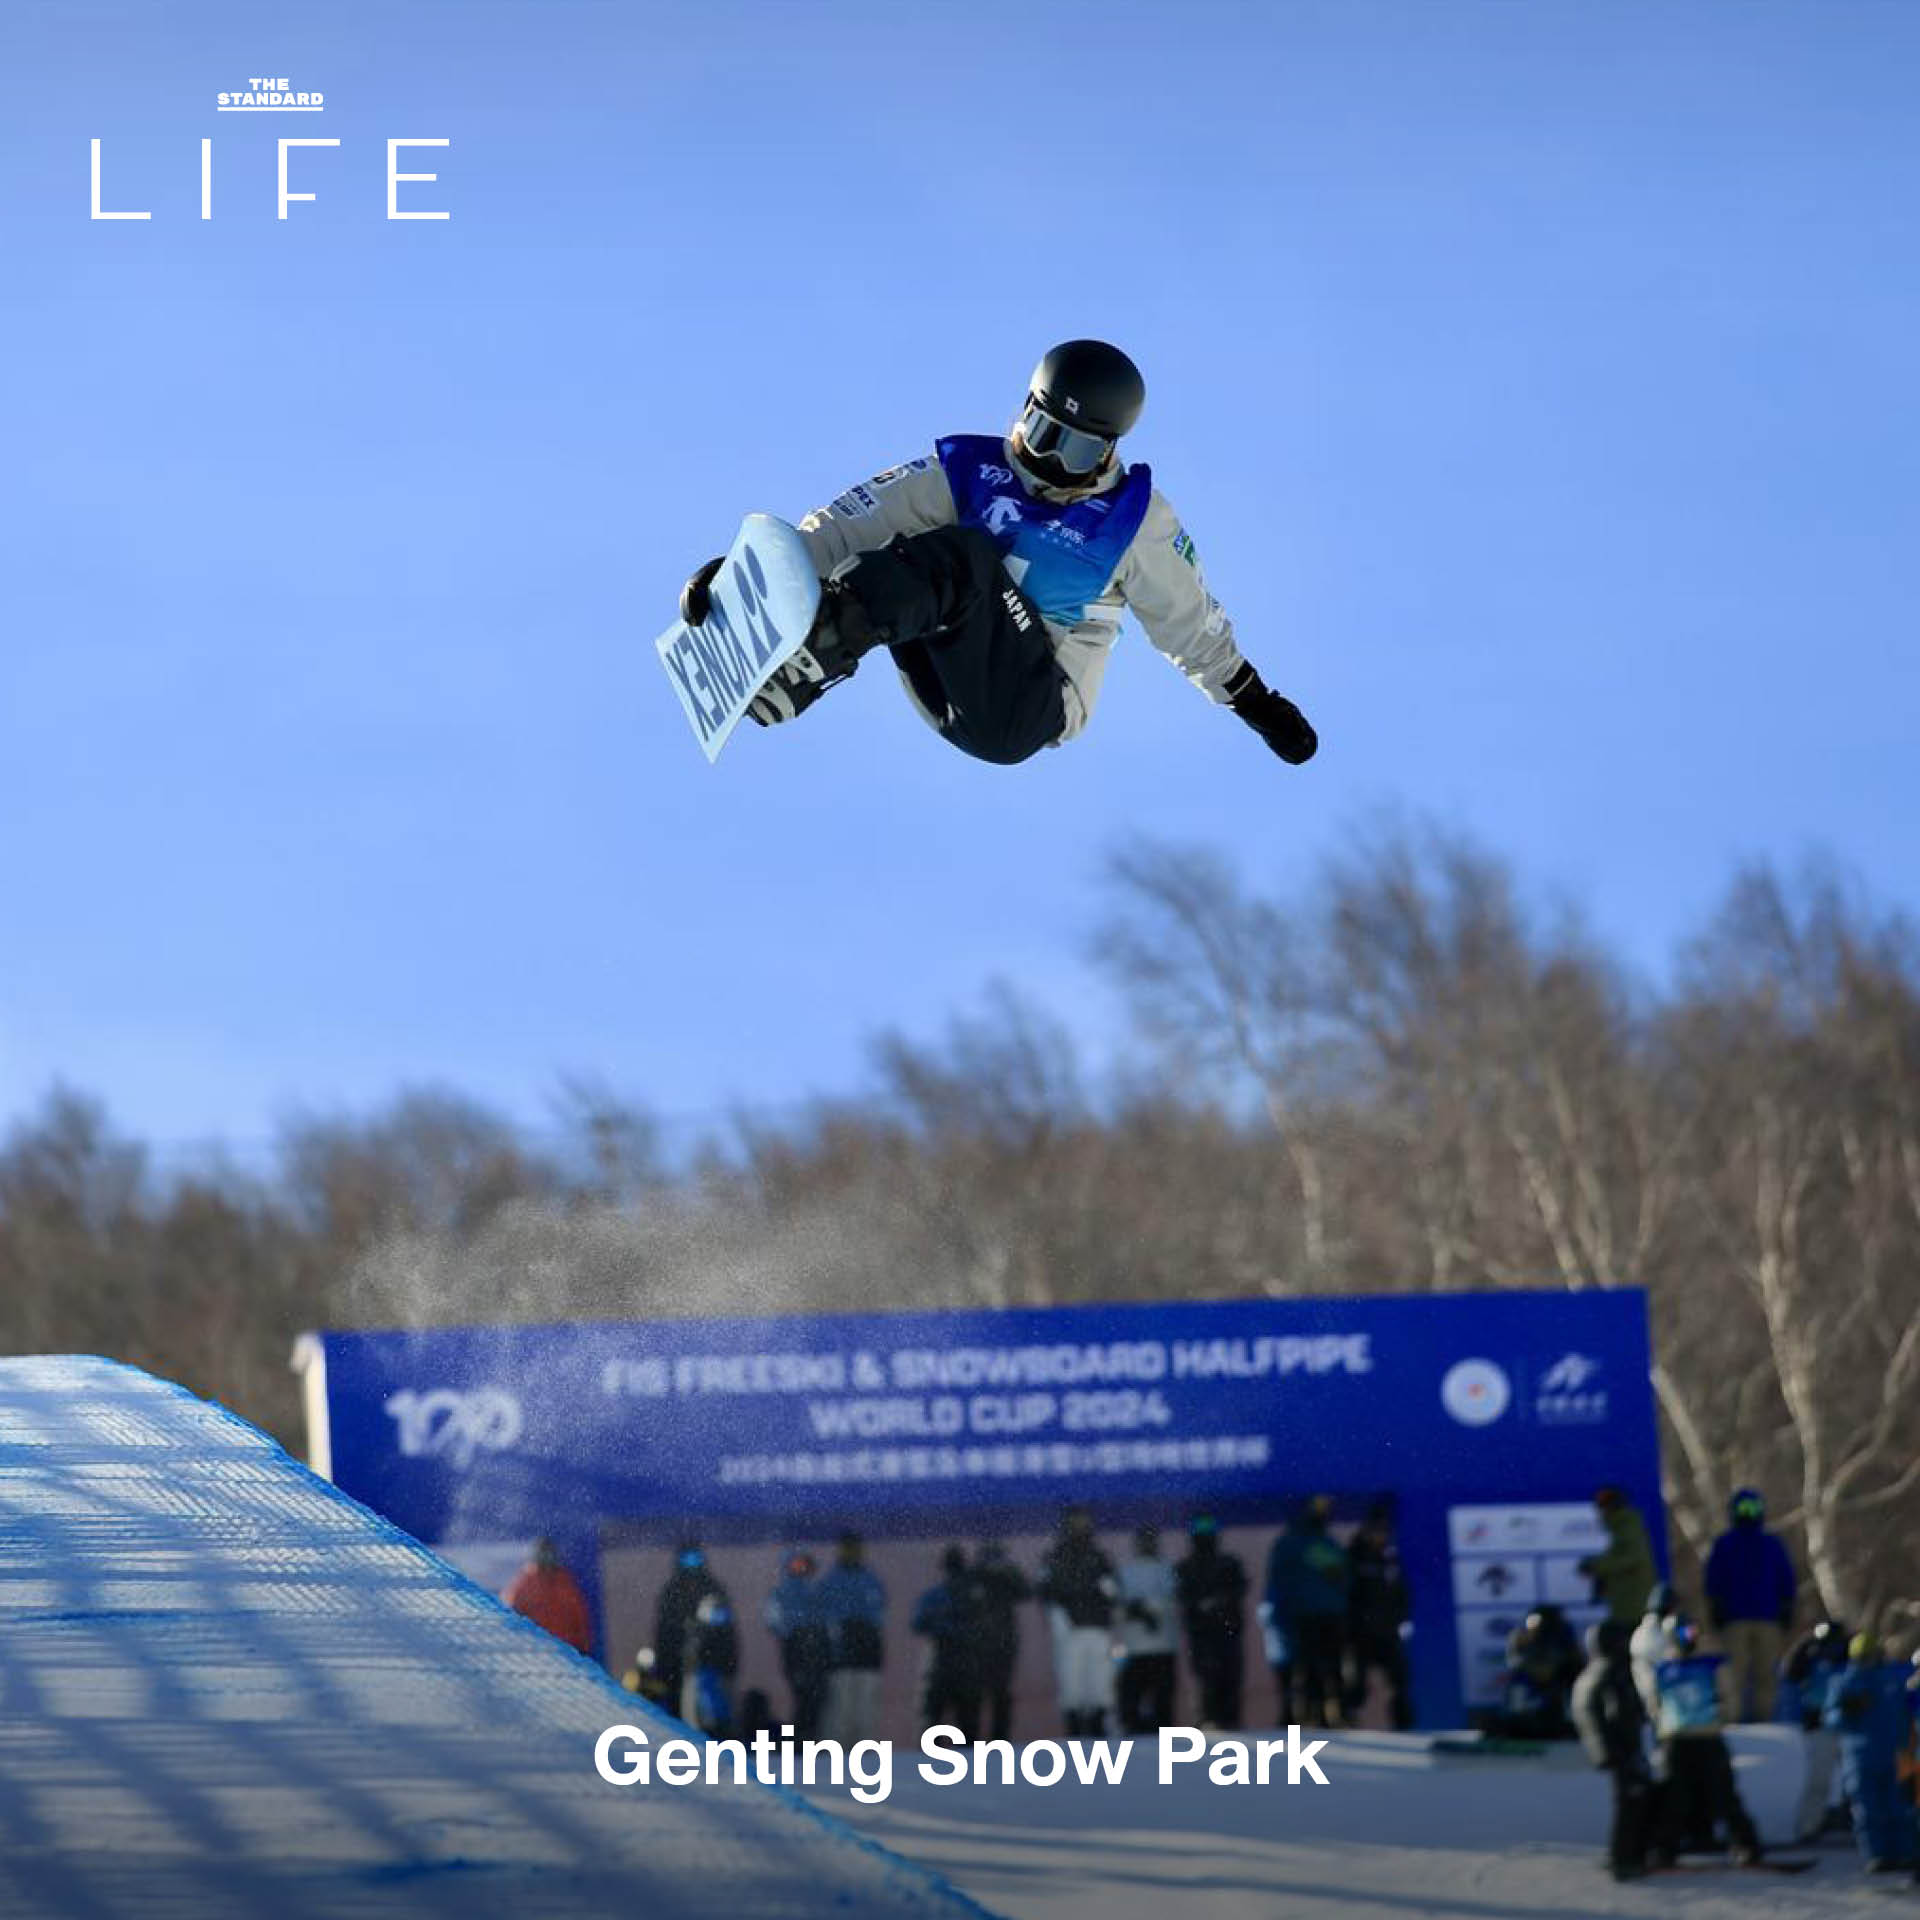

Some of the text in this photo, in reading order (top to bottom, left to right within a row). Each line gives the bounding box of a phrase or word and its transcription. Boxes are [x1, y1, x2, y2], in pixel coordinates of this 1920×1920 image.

[1002, 588, 1032, 632] JAPAN
[674, 1352, 846, 1395] FREESKI
[851, 1350, 887, 1391] &
[890, 1341, 1166, 1388] SNOWBOARD
[1170, 1333, 1373, 1379] HALFPIPE
[809, 1390, 1174, 1440] WORLD CUP 2024
